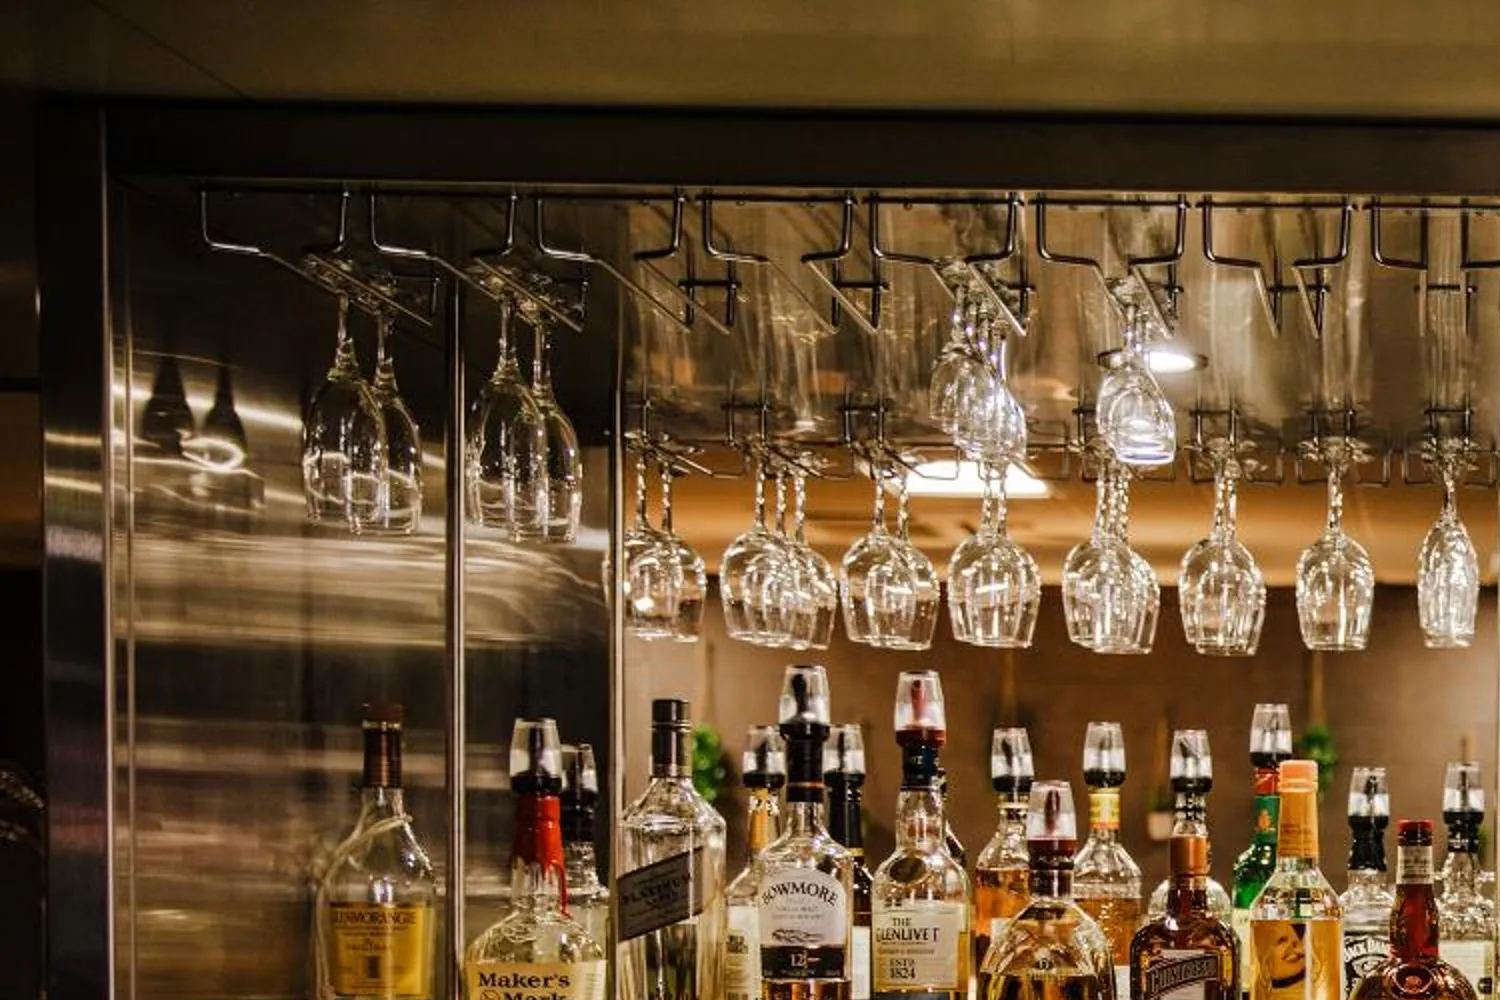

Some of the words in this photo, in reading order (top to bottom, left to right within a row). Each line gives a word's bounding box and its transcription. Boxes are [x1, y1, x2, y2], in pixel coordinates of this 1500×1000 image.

[762, 881, 839, 906] BOWMORE
[891, 917, 912, 927] THE
[479, 971, 571, 989] Maker's
